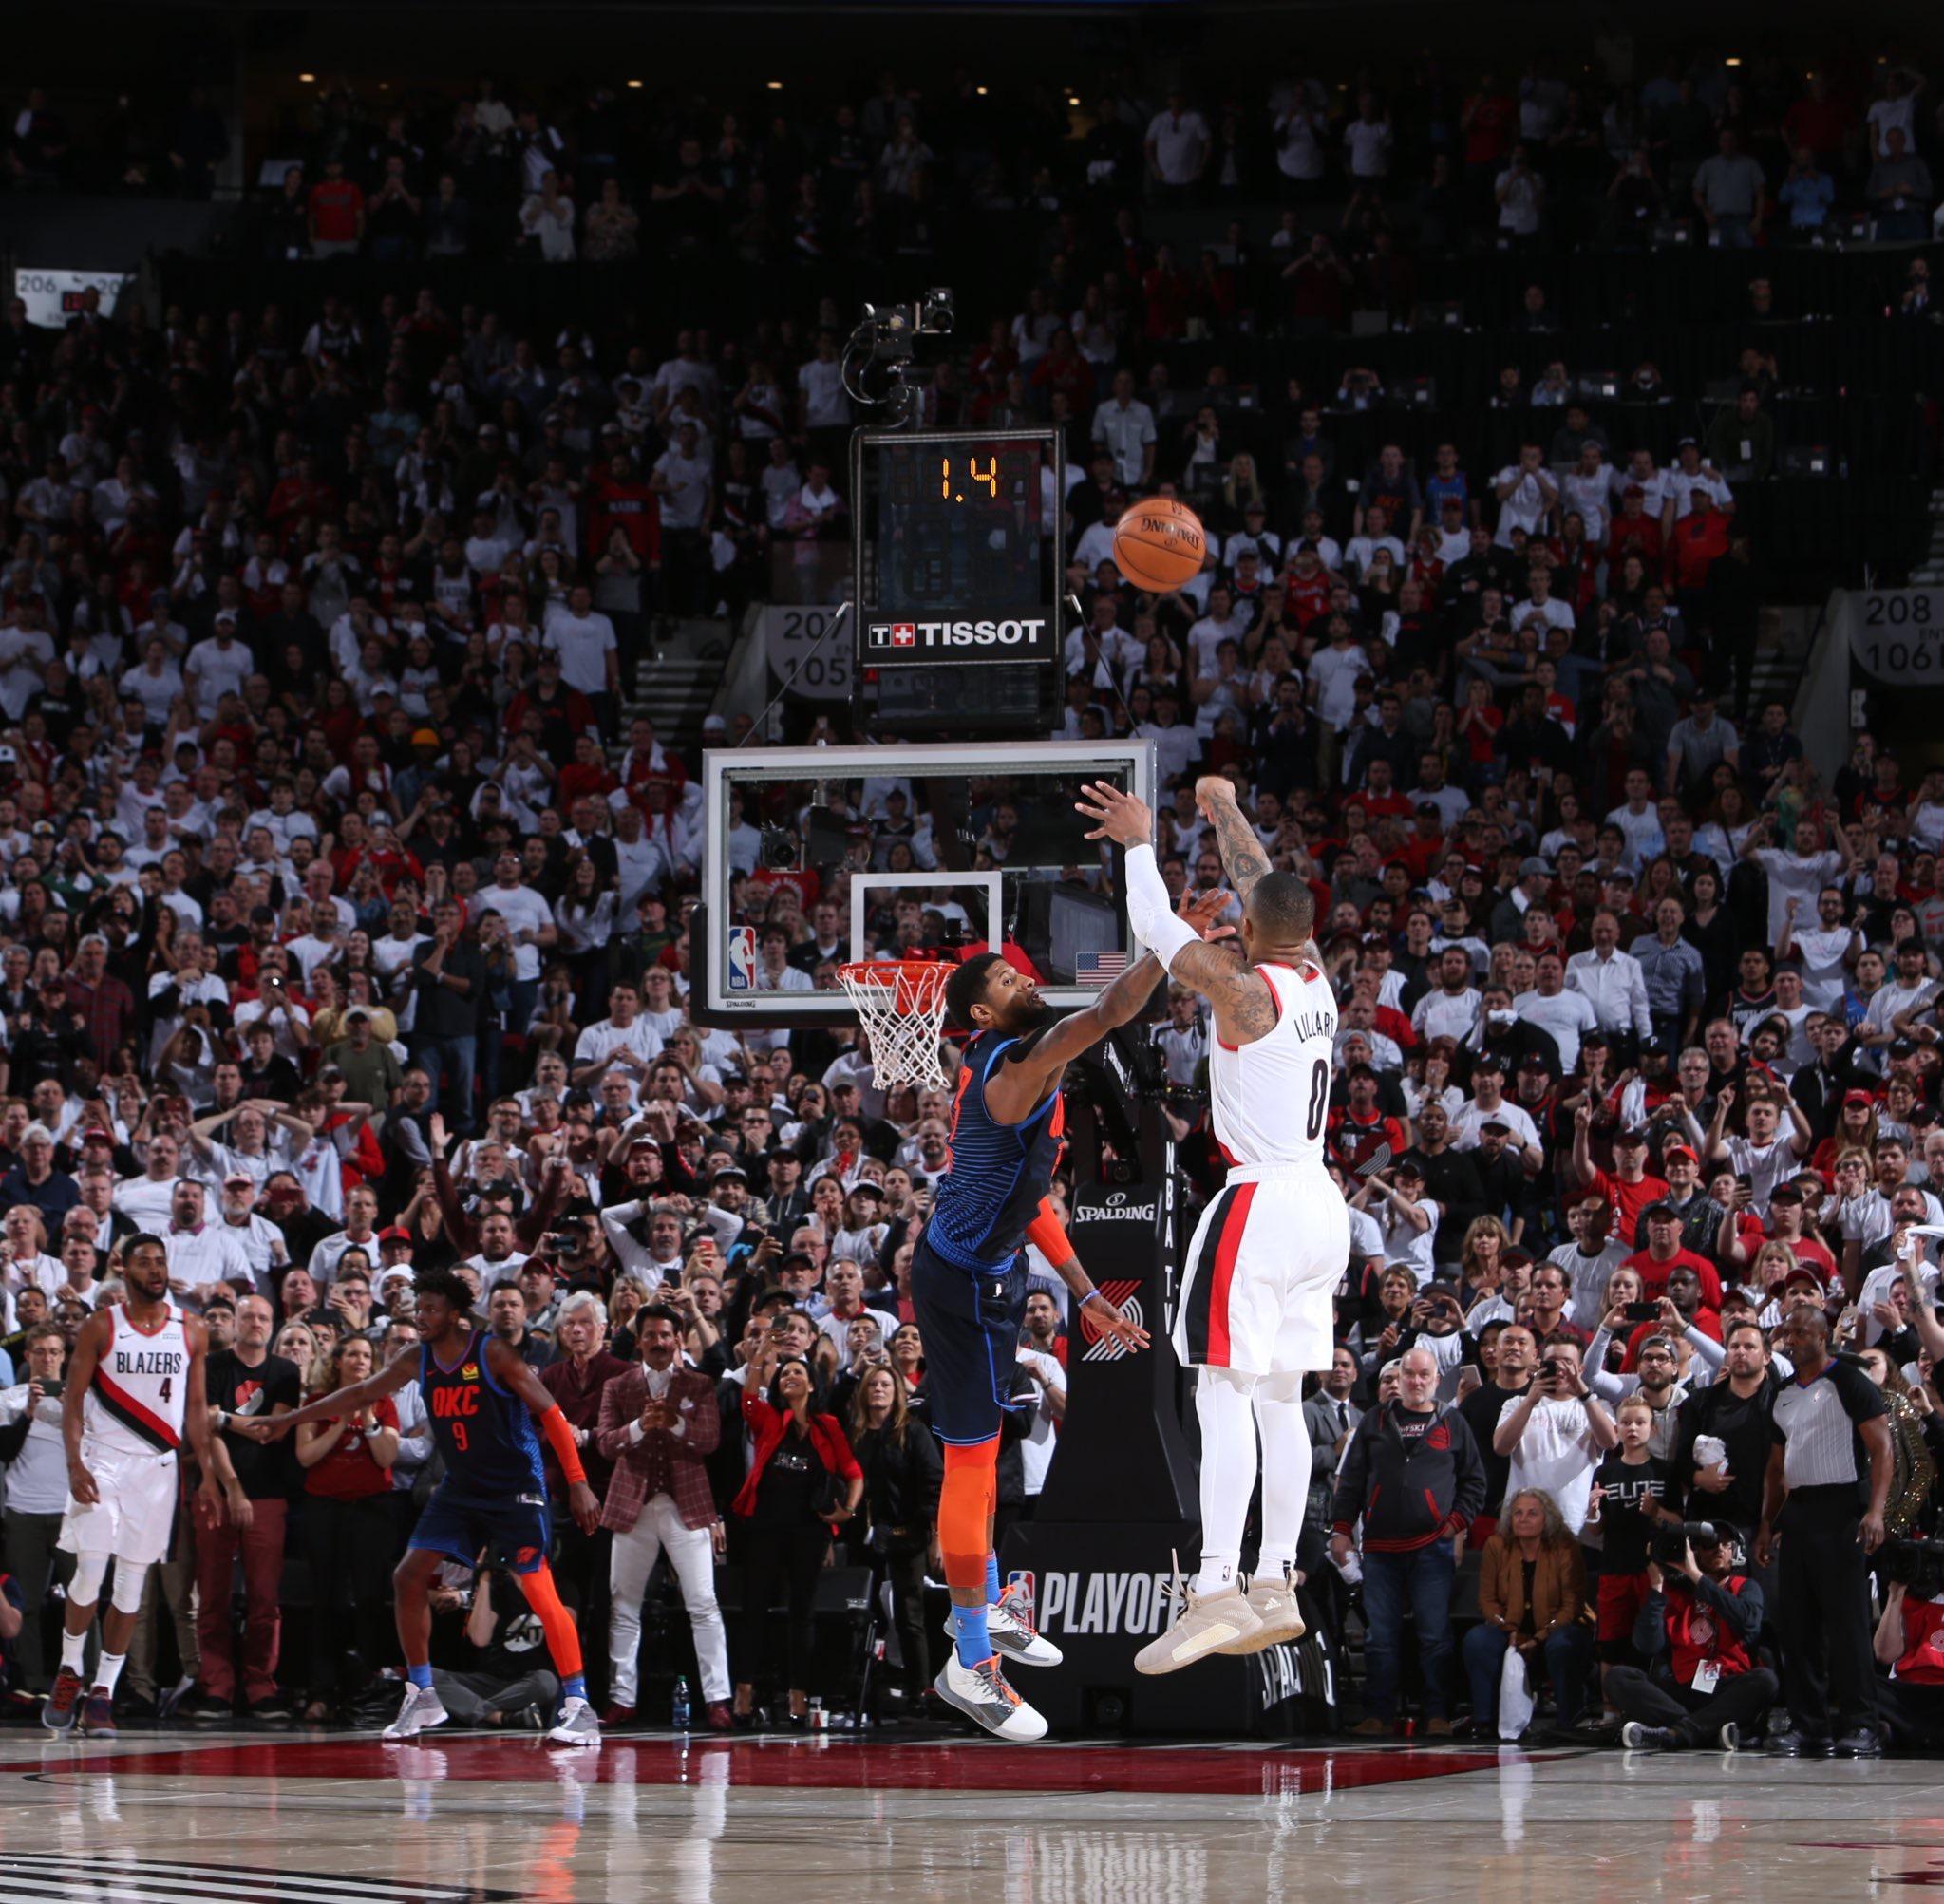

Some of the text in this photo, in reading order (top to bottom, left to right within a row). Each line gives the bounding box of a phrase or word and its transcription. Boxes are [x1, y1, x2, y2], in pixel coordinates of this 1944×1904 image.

[20, 275, 56, 293] 206
[942, 456, 997, 503] 1.4
[1866, 595, 1931, 624] 208
[784, 612, 846, 640] 207
[917, 620, 1045, 647] TISSOT
[1867, 643, 1932, 671] 106
[784, 657, 847, 686] 105
[1307, 1059, 1328, 1140] 0
[1075, 1203, 1156, 1223] SPALDING
[1164, 1141, 1175, 1334] NBA TV
[115, 1351, 182, 1375] BLAZERS
[159, 1377, 172, 1404] 4
[431, 1384, 481, 1418] OKC
[451, 1420, 470, 1453] 9
[1605, 1480, 1665, 1500] ELITE
